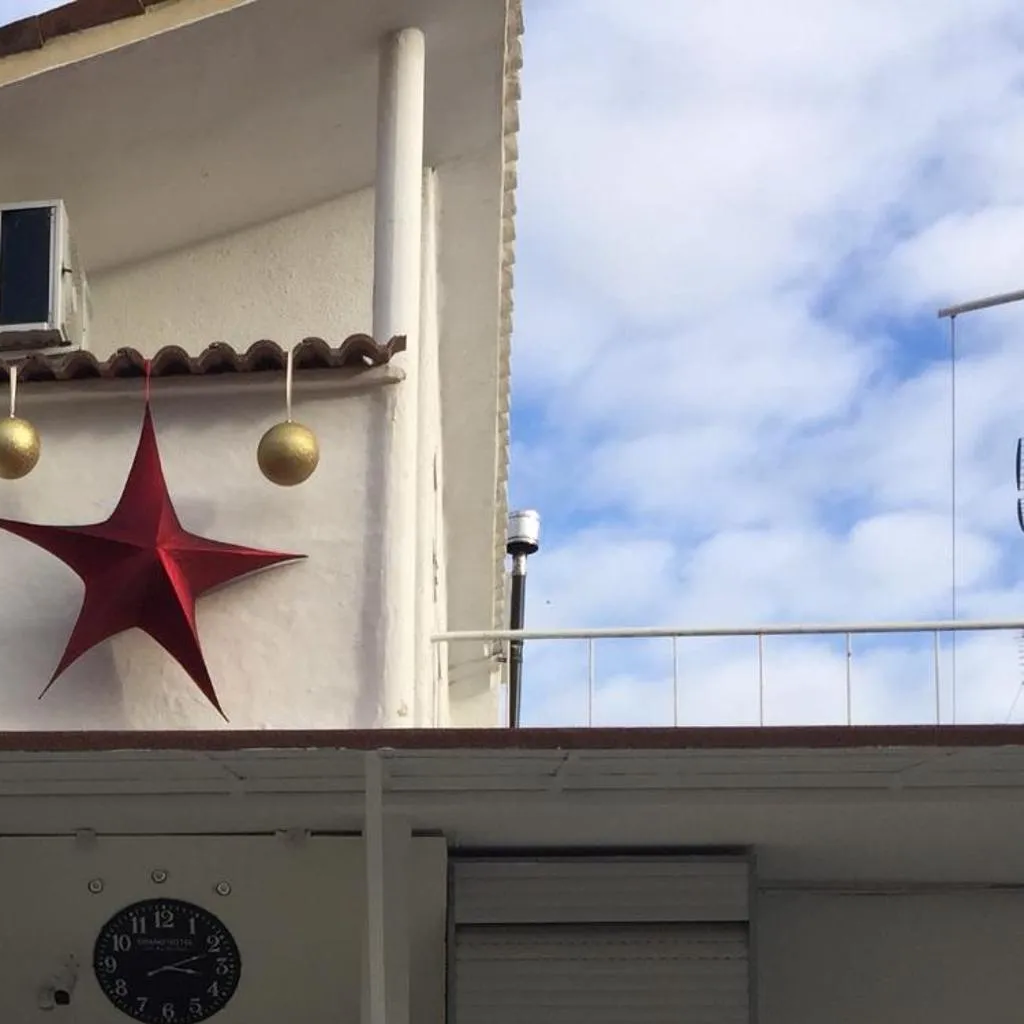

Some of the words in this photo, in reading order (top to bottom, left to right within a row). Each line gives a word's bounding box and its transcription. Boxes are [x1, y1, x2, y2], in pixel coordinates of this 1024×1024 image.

[132, 916, 146, 934] 11
[155, 910, 174, 928] 12
[189, 917, 196, 935] 1
[112, 934, 132, 952] 10
[206, 935, 221, 953] 2
[104, 956, 117, 973] 9
[216, 957, 229, 975] 3
[115, 978, 128, 996] 8
[207, 980, 219, 997] 4
[136, 996, 148, 1012] 7
[162, 1002, 174, 1019] 6
[189, 998, 201, 1014] 5
